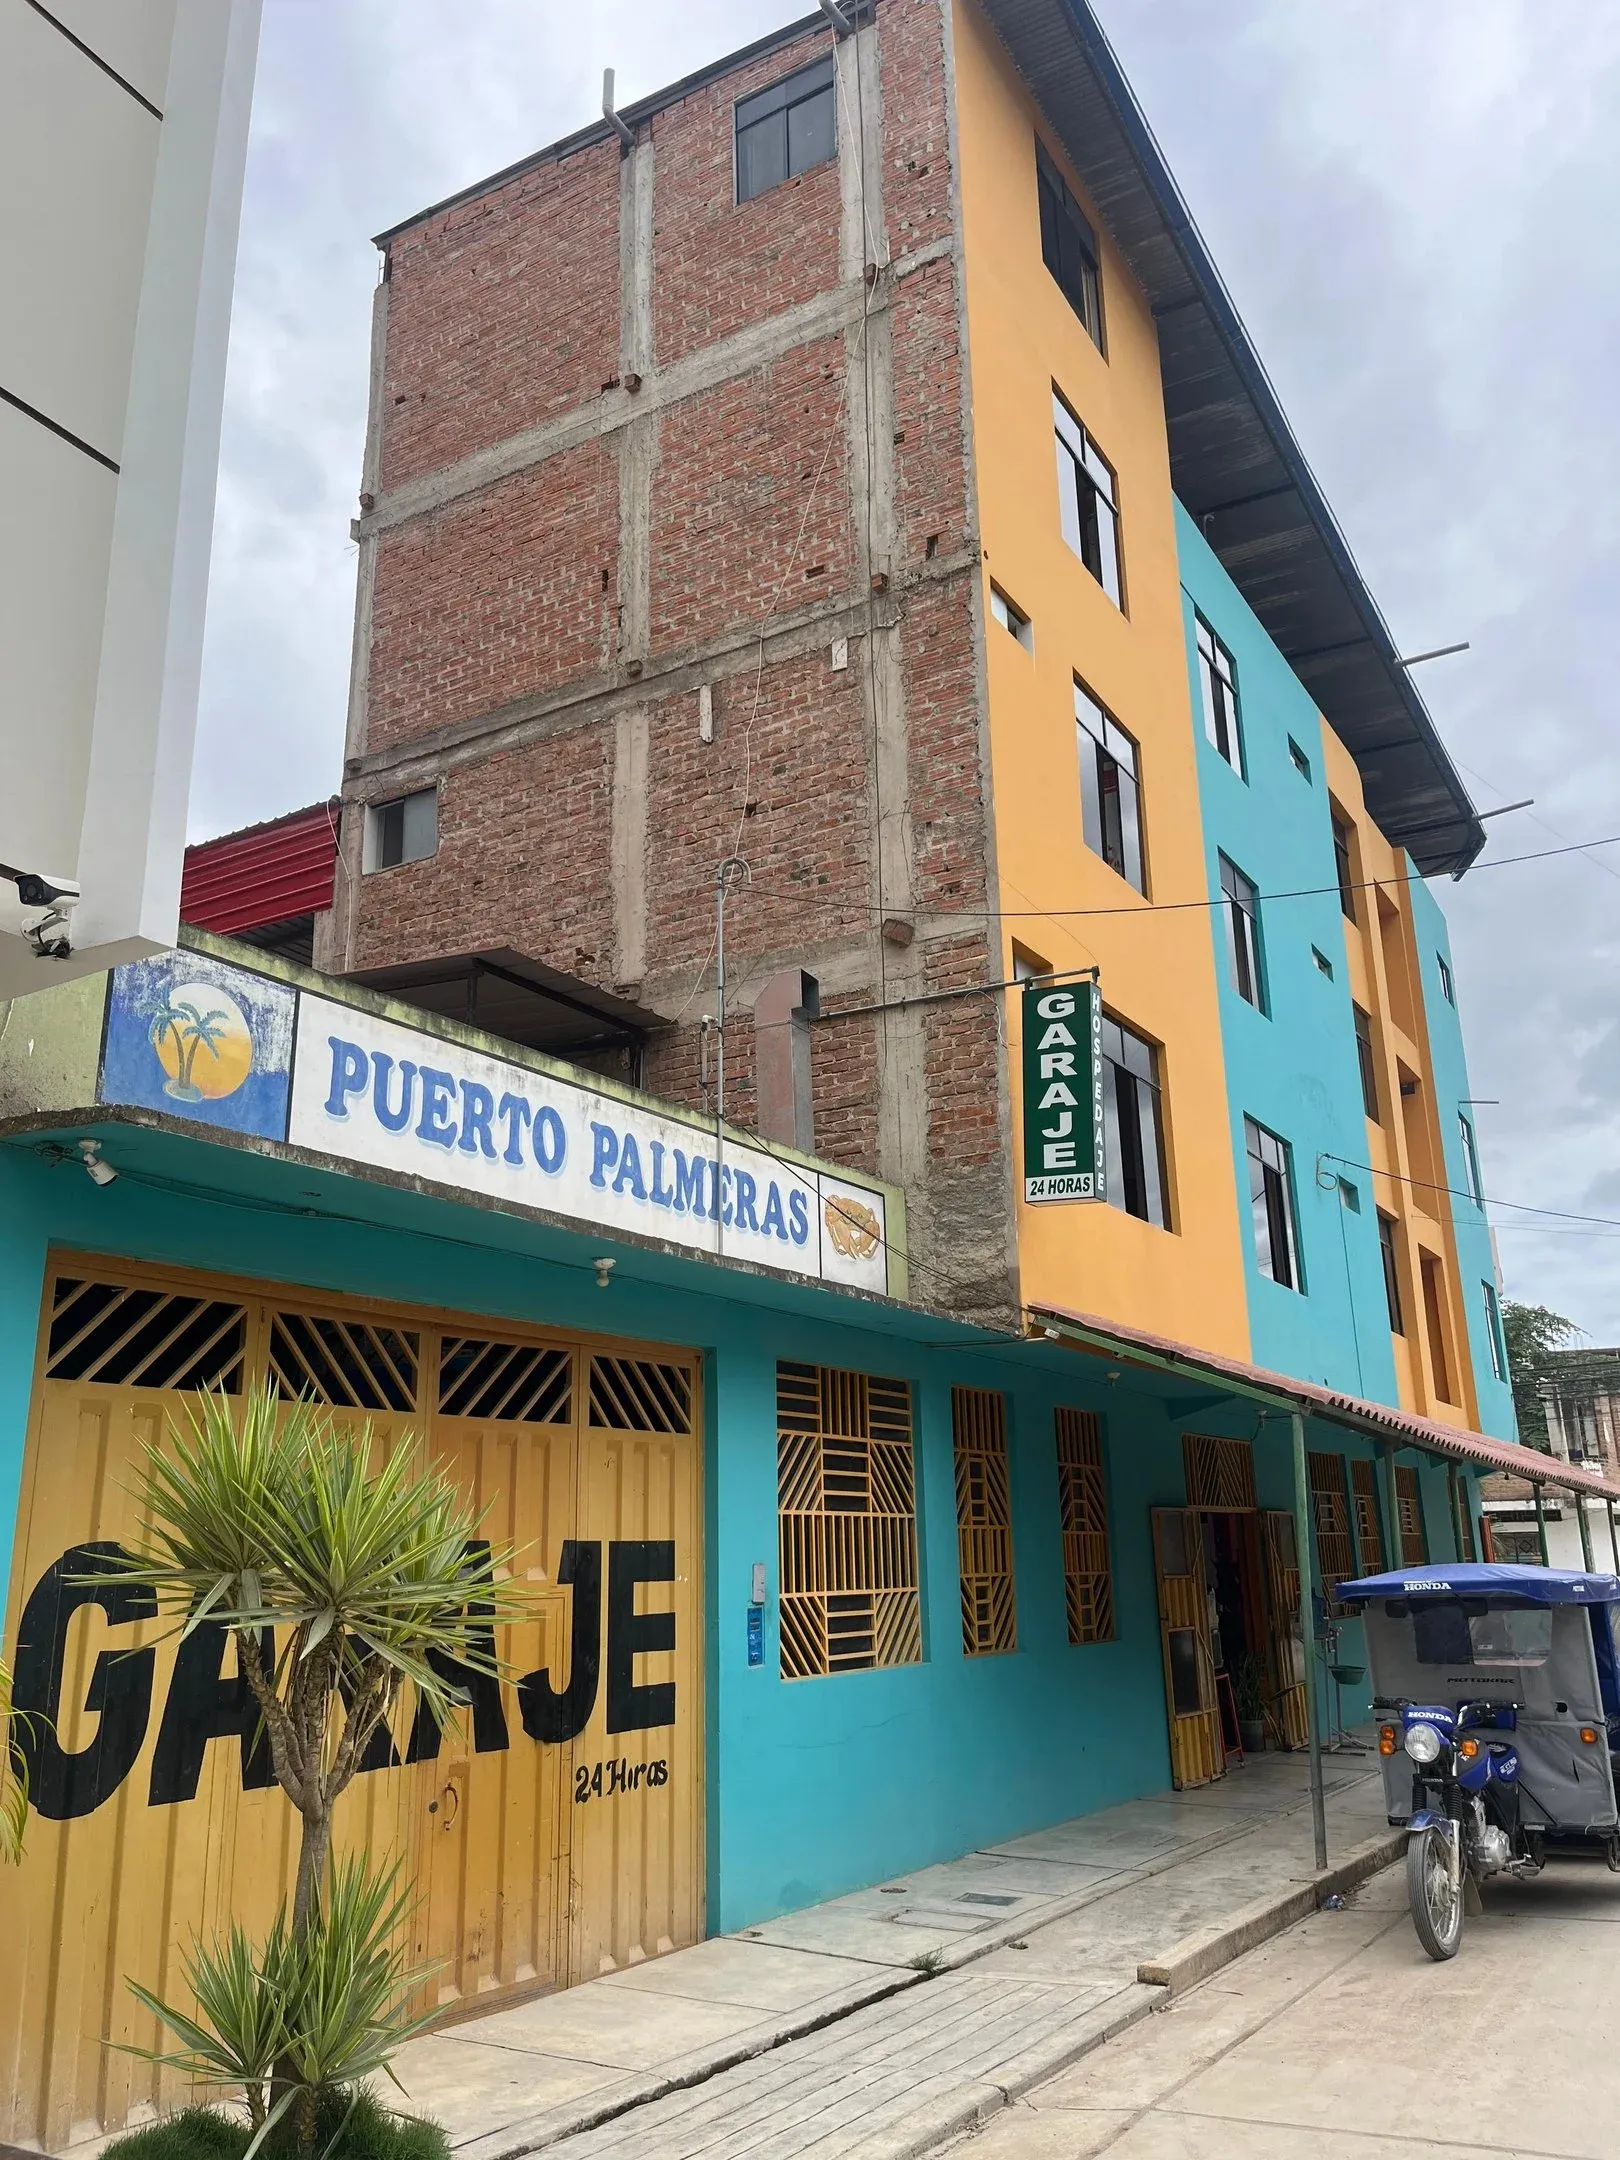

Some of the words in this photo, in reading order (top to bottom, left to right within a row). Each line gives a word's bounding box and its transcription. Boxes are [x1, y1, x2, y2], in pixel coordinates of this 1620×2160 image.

[1036, 992, 1079, 1170] GARAJE
[1091, 992, 1105, 1192] HOSPEDAJE
[323, 1035, 568, 1177] PUERTO
[588, 1119, 810, 1247] PALMERAS
[1029, 1180, 1045, 1196] 24
[1048, 1176, 1091, 1195] HORAS
[1403, 1582, 1452, 1591] HONDA
[1407, 1711, 1453, 1724] HONDA
[575, 1762, 603, 1804] 24
